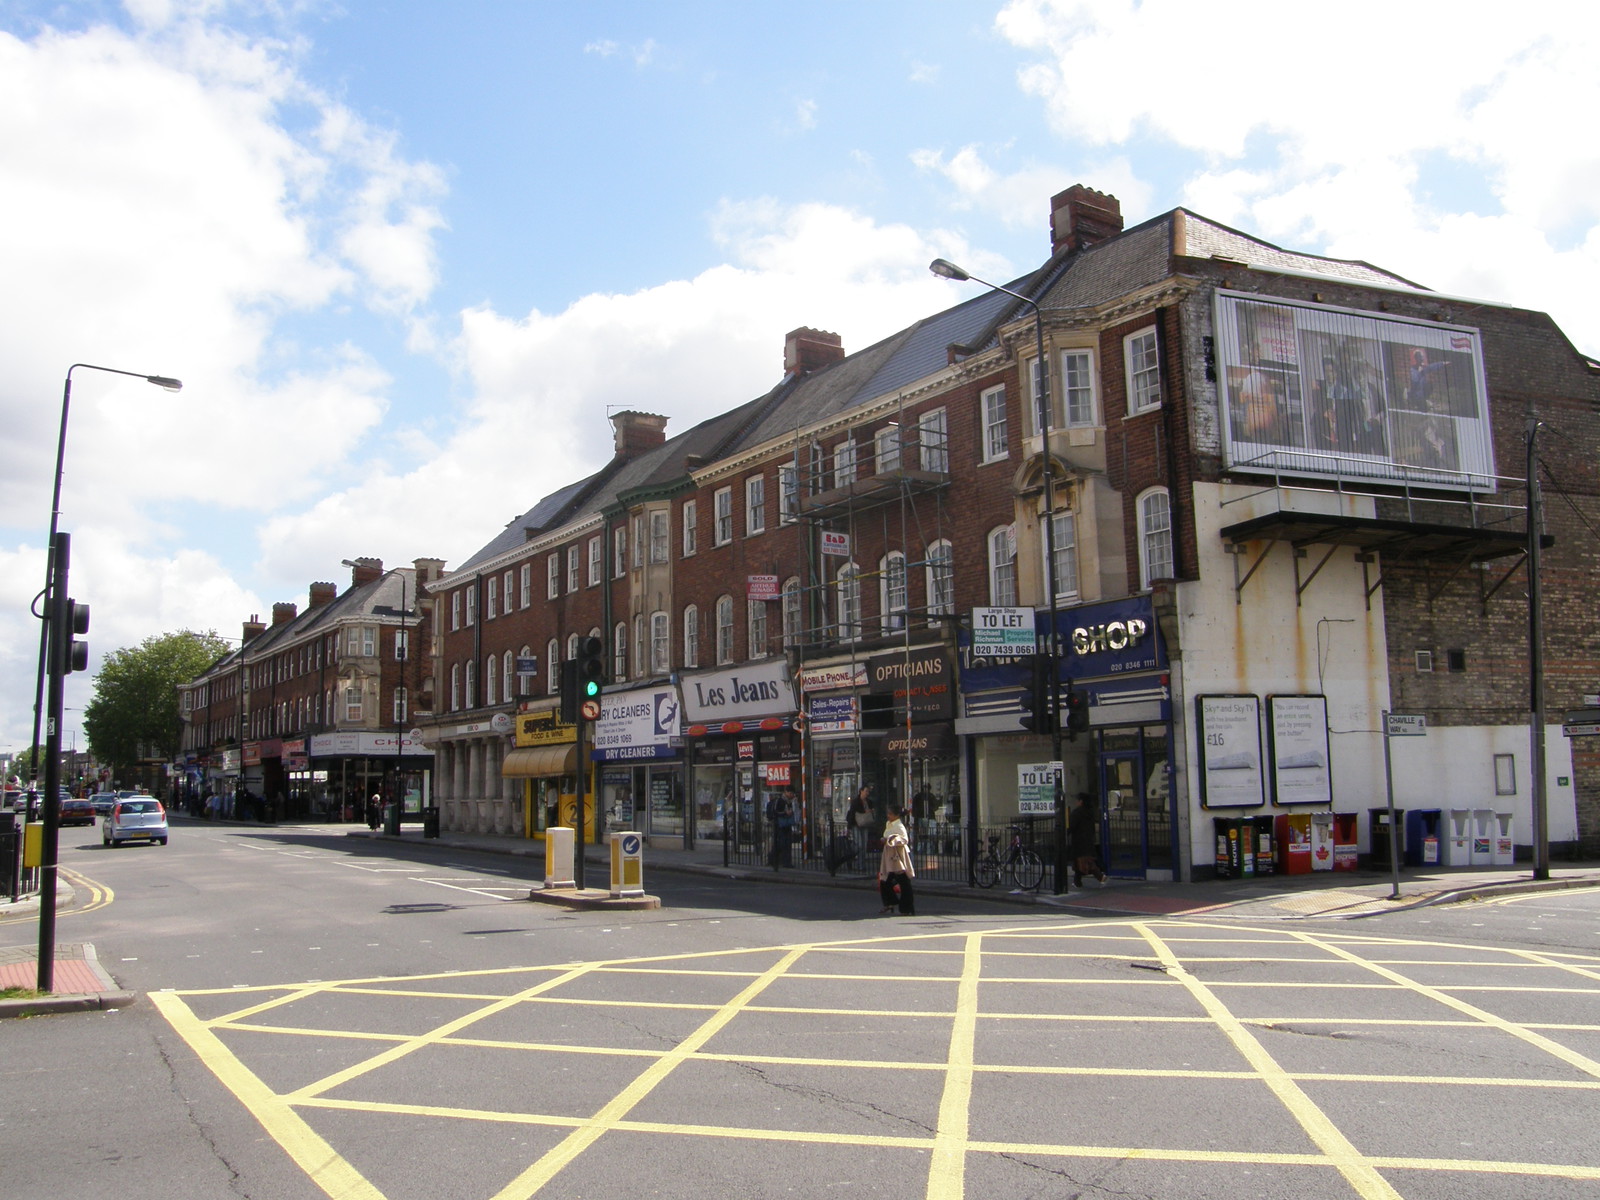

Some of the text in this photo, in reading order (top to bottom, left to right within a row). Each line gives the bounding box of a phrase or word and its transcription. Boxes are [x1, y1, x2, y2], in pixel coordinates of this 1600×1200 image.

[982, 615, 1023, 627] TO LET
[1072, 619, 1146, 655] SHOP
[976, 646, 1035, 654] 020 7439 0661
[876, 658, 942, 681] OPTICIANS
[1125, 661, 1140, 669] 8346
[826, 672, 850, 683] PHONE
[695, 677, 779, 708] Les Jeans
[612, 704, 651, 720] CLEANERS
[1234, 704, 1245, 714] Sky
[1246, 704, 1254, 712] TV
[1389, 716, 1415, 724] CHAVILLE
[551, 730, 564, 738] WINE
[1206, 733, 1225, 746] £16
[605, 746, 656, 759] DRY CLEANERS
[768, 767, 790, 781] SALE
[1022, 773, 1036, 784] TO
